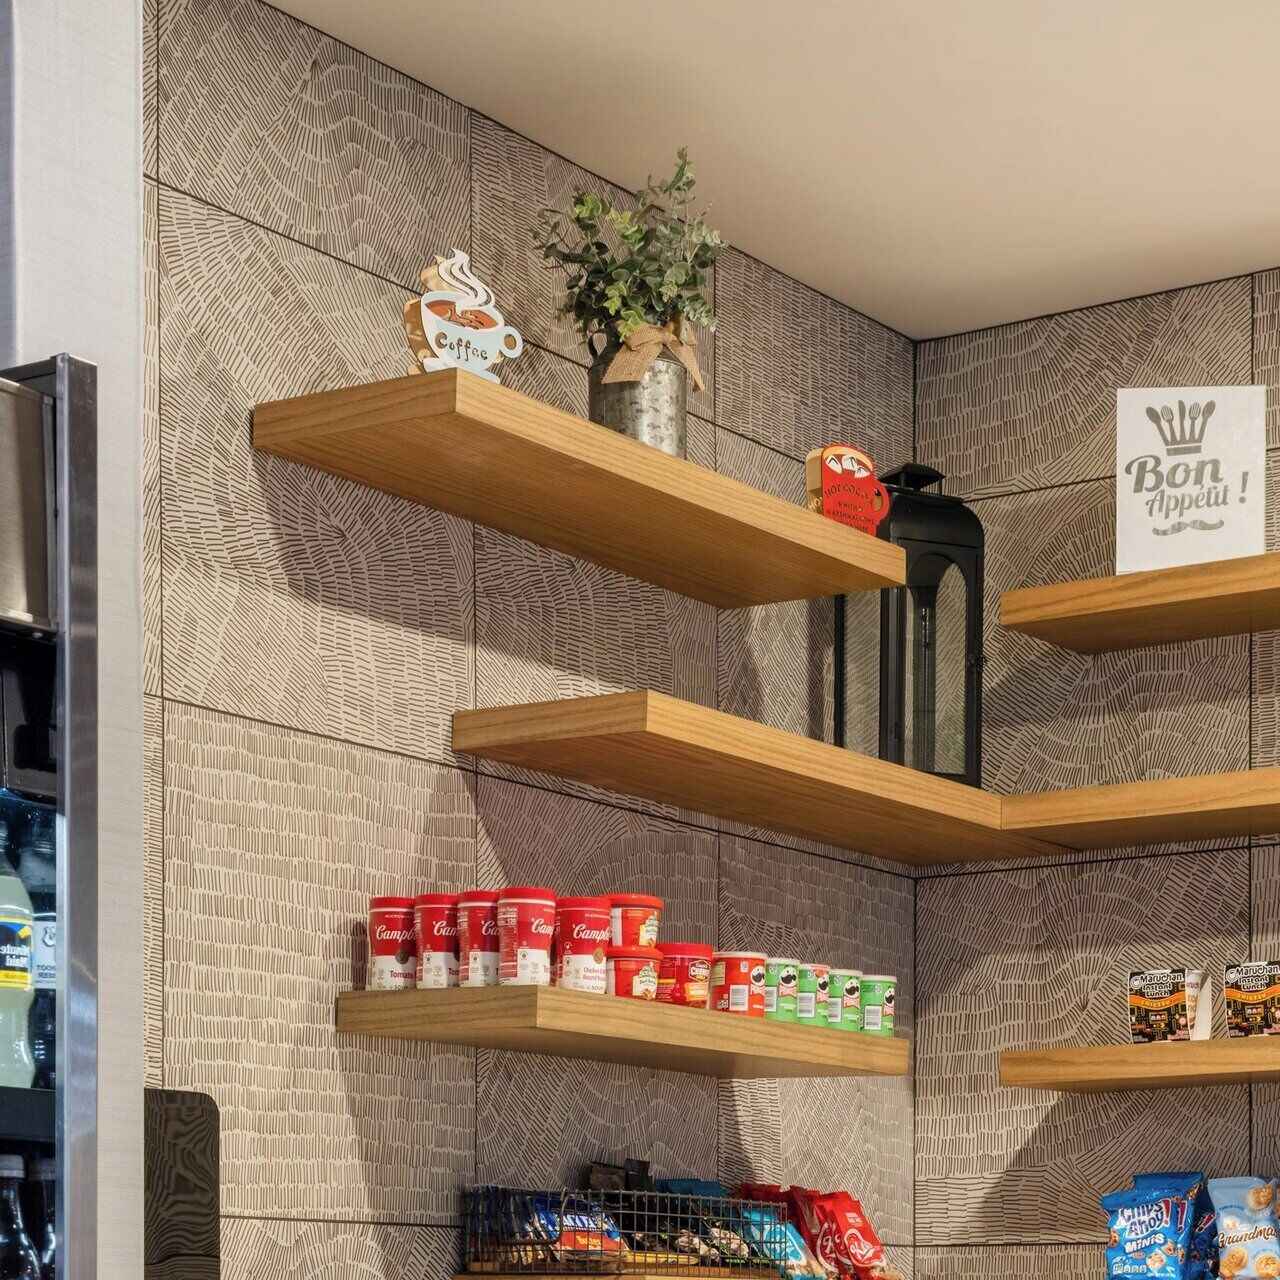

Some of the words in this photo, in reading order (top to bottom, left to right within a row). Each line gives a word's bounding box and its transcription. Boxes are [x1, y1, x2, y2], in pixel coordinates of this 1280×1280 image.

[435, 332, 488, 361] Coffee
[1125, 455, 1224, 493] Bon
[1236, 965, 1280, 977] Maruchan
[1140, 972, 1183, 984] Maruchan
[1238, 975, 1269, 984] Instant
[1142, 982, 1172, 991] Instant
[1242, 982, 1267, 990] Lunch
[1145, 989, 1170, 997] Lunch
